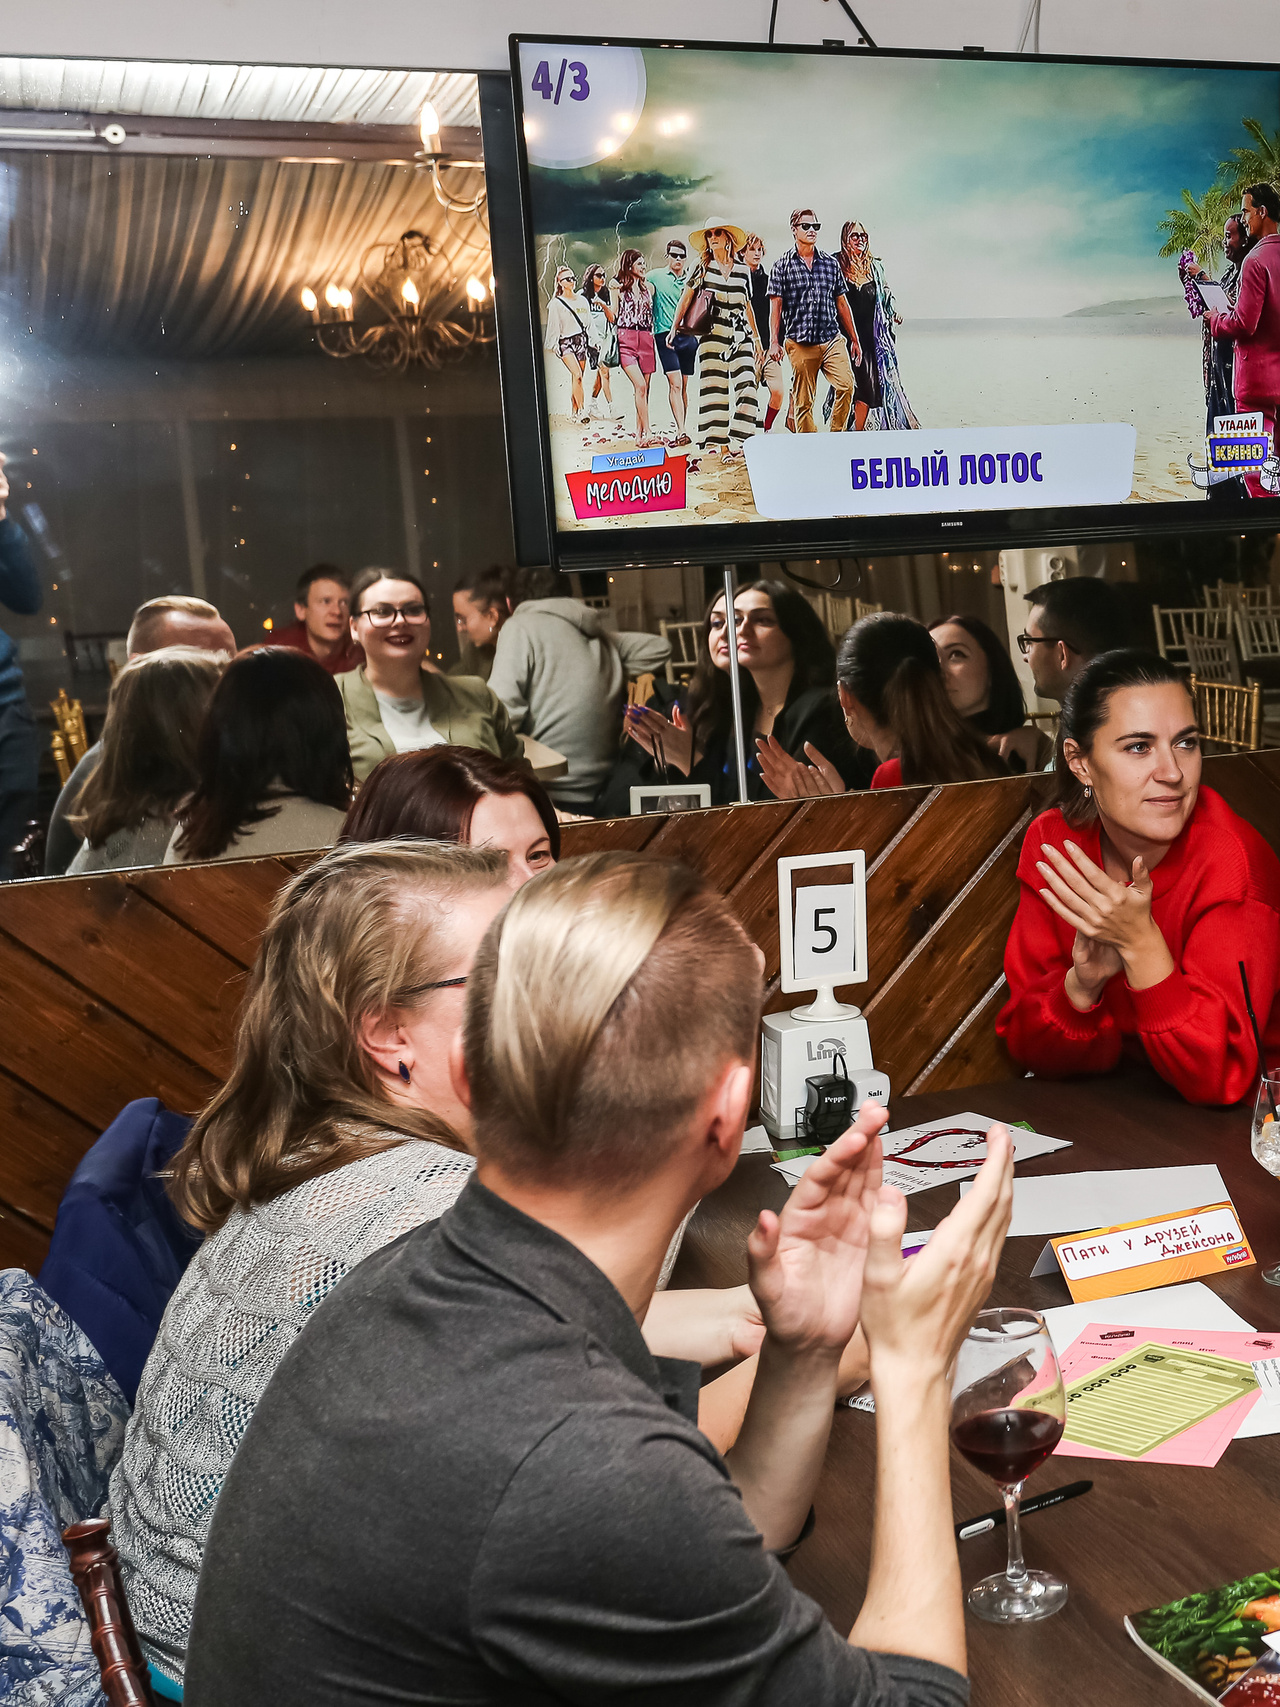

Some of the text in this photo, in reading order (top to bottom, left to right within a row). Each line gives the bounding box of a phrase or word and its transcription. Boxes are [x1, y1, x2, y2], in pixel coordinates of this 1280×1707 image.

[531, 58, 590, 105] 4/3
[1219, 416, 1257, 431] УГАДАЙ
[607, 453, 645, 466] Угадай
[1215, 444, 1264, 461] КИНО
[851, 450, 1043, 489] БЕЛЫЙ ЛОТОС
[812, 908, 837, 953] 5
[807, 1038, 847, 1061] Lime
